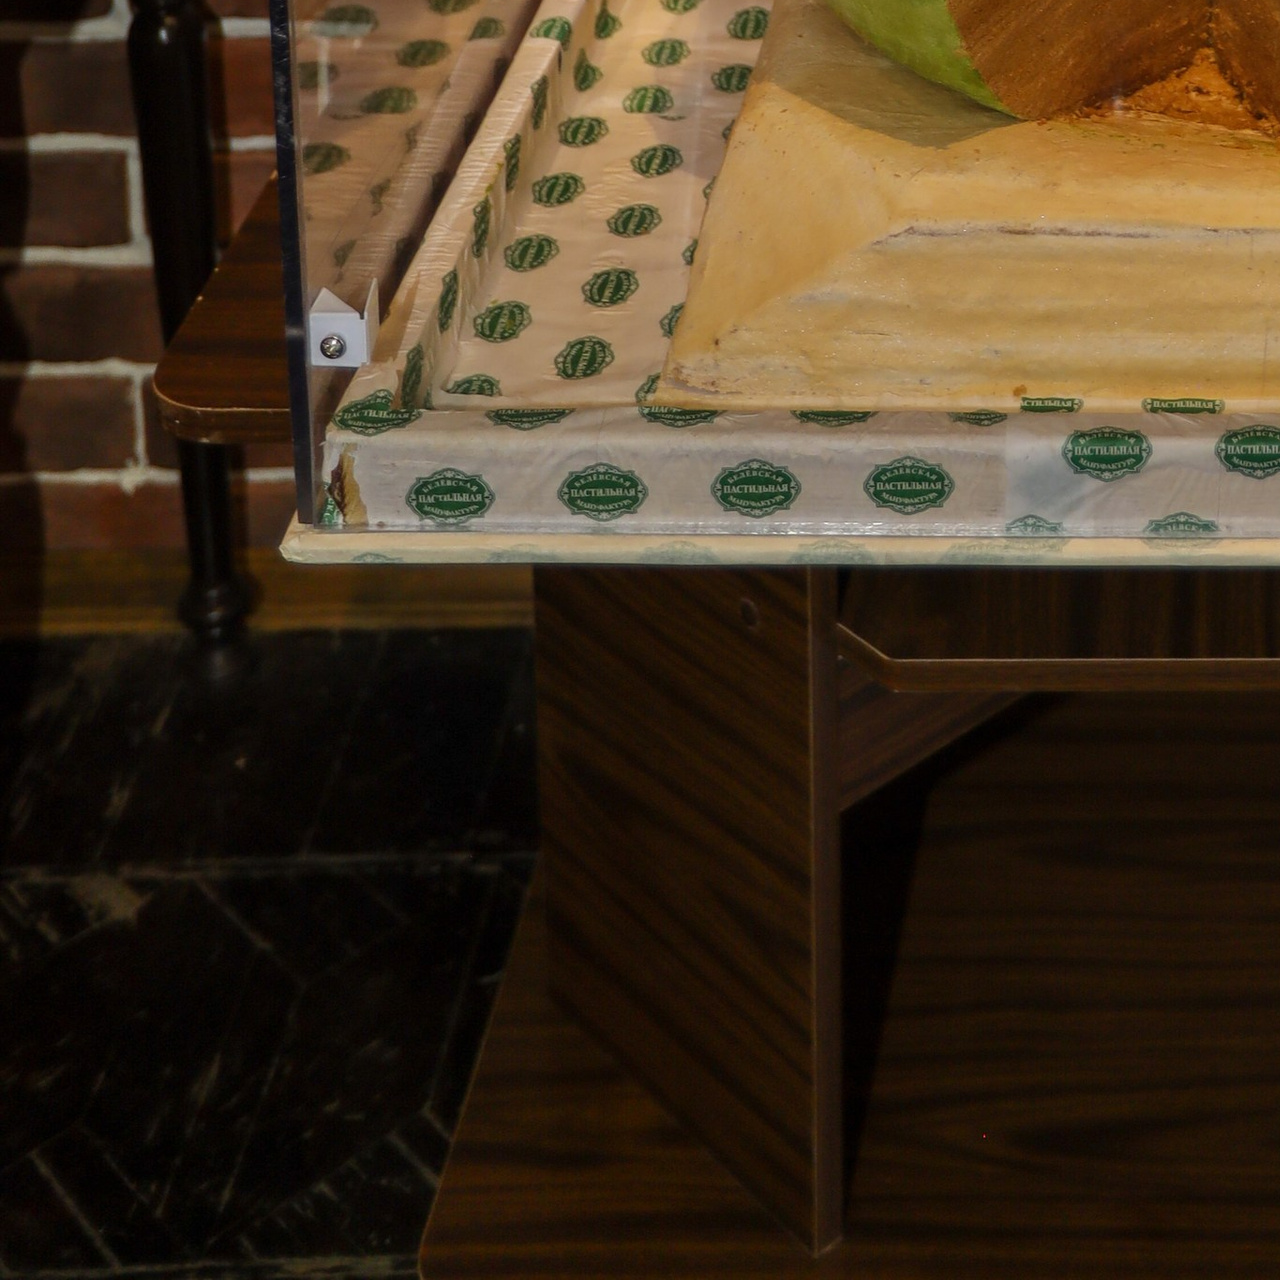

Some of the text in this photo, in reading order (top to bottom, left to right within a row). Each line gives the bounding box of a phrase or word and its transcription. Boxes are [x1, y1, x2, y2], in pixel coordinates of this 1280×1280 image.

[1074, 445, 1141, 456] ПАСТИЛЬНАЯ
[723, 484, 789, 494] ПАСТИЛЬНАЯ
[876, 481, 942, 490] ПАСТИЛЬНАЯ
[570, 487, 636, 497] ПАСТИЛЬНАЯ
[418, 493, 483, 503] ПАСТИЛЬНАЯ
